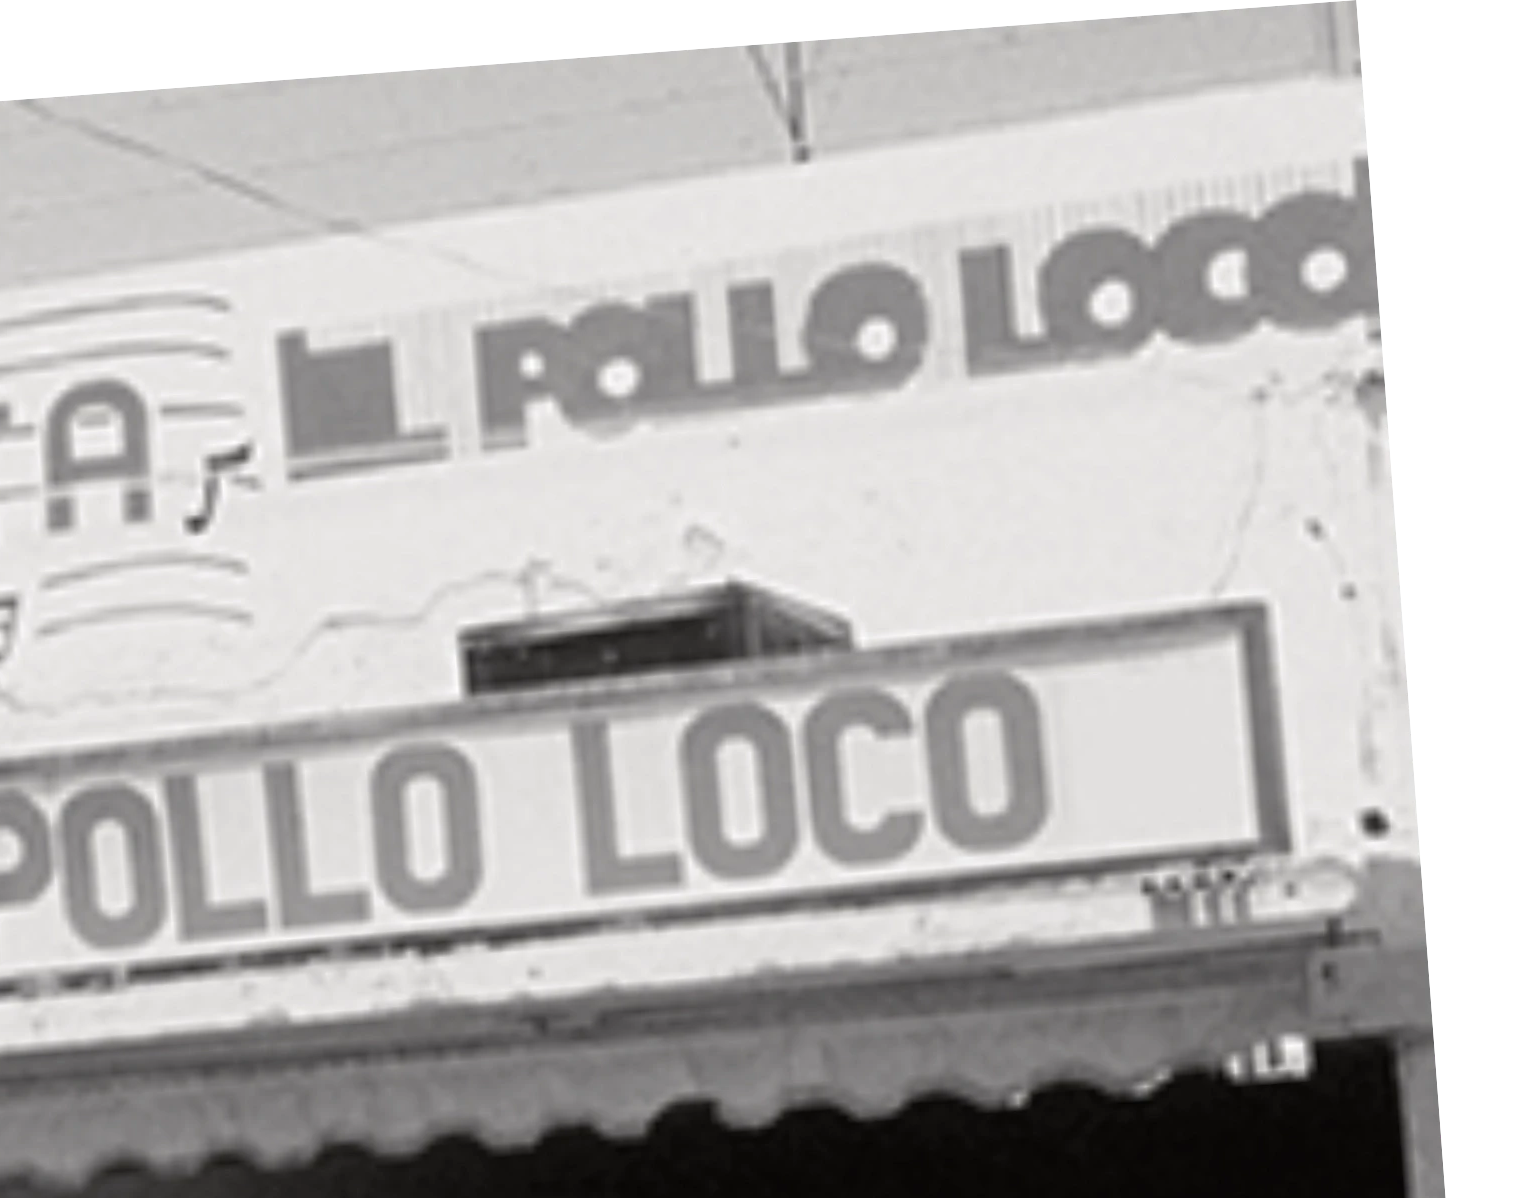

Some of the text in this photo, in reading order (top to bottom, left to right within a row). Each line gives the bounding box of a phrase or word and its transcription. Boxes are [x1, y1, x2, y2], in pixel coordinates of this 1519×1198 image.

[473, 261, 928, 450] POLLO
[958, 190, 1380, 378] LOCO
[569, 666, 1051, 898] LOCO
